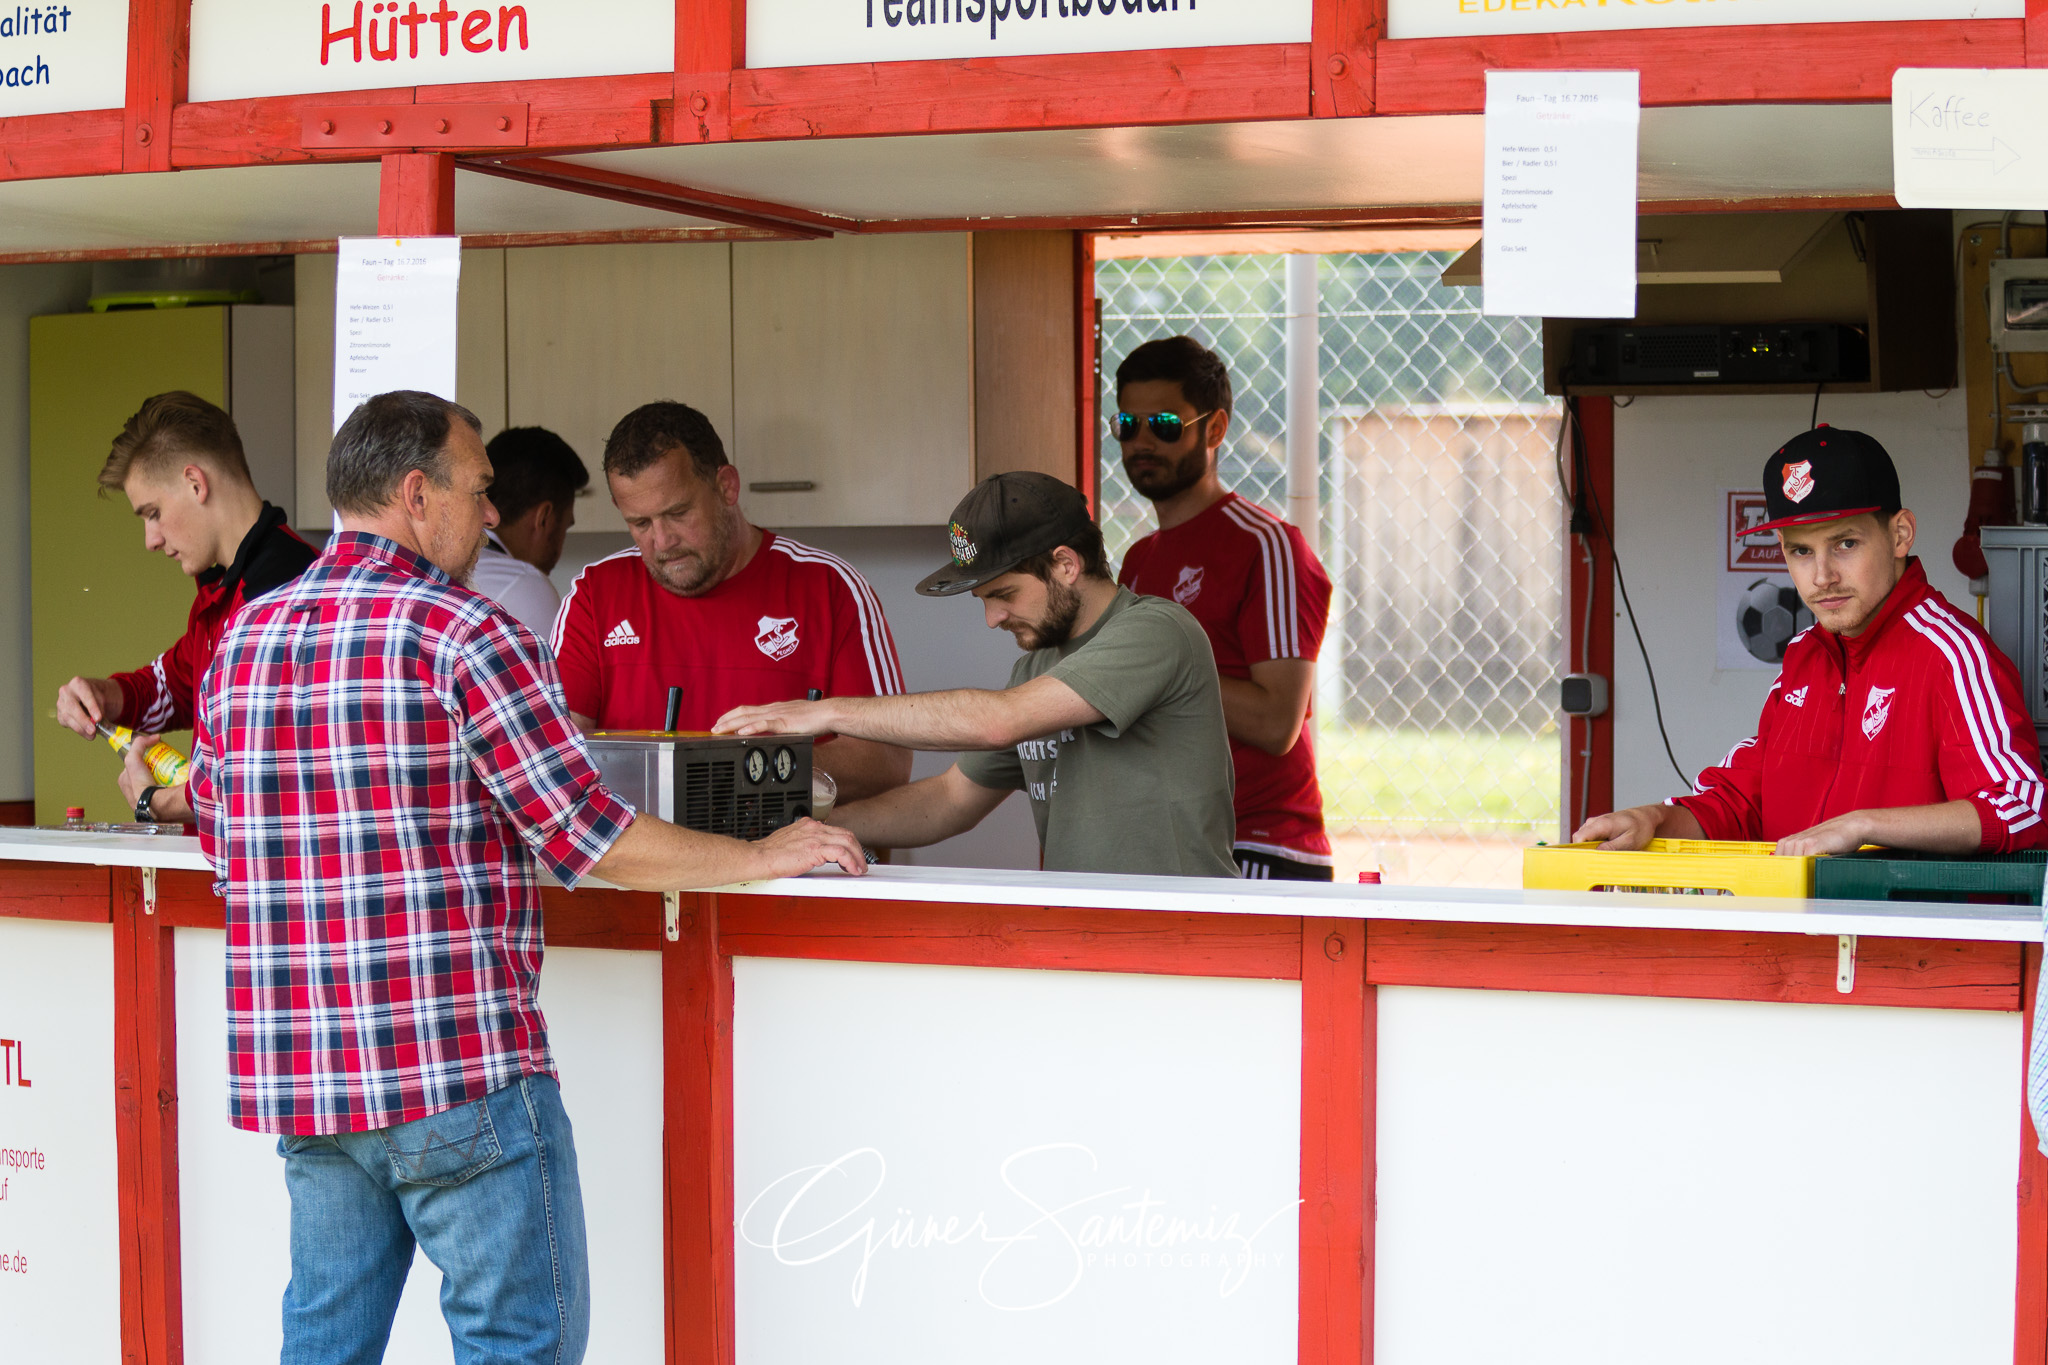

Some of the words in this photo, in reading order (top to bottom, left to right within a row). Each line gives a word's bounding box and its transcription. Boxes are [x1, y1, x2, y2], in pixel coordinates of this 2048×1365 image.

[320, 0, 528, 65] Hütten
[0, 54, 49, 87] ach
[1516, 94, 1535, 103] Faun
[1543, 94, 1557, 104] Tag
[1909, 91, 1990, 131] Kaffee
[383, 258, 394, 267] Tag
[1750, 548, 1780, 559] LAUF
[603, 634, 641, 648] adidas
[0, 1147, 45, 1173] nsporte
[0, 1249, 28, 1274] e.de
